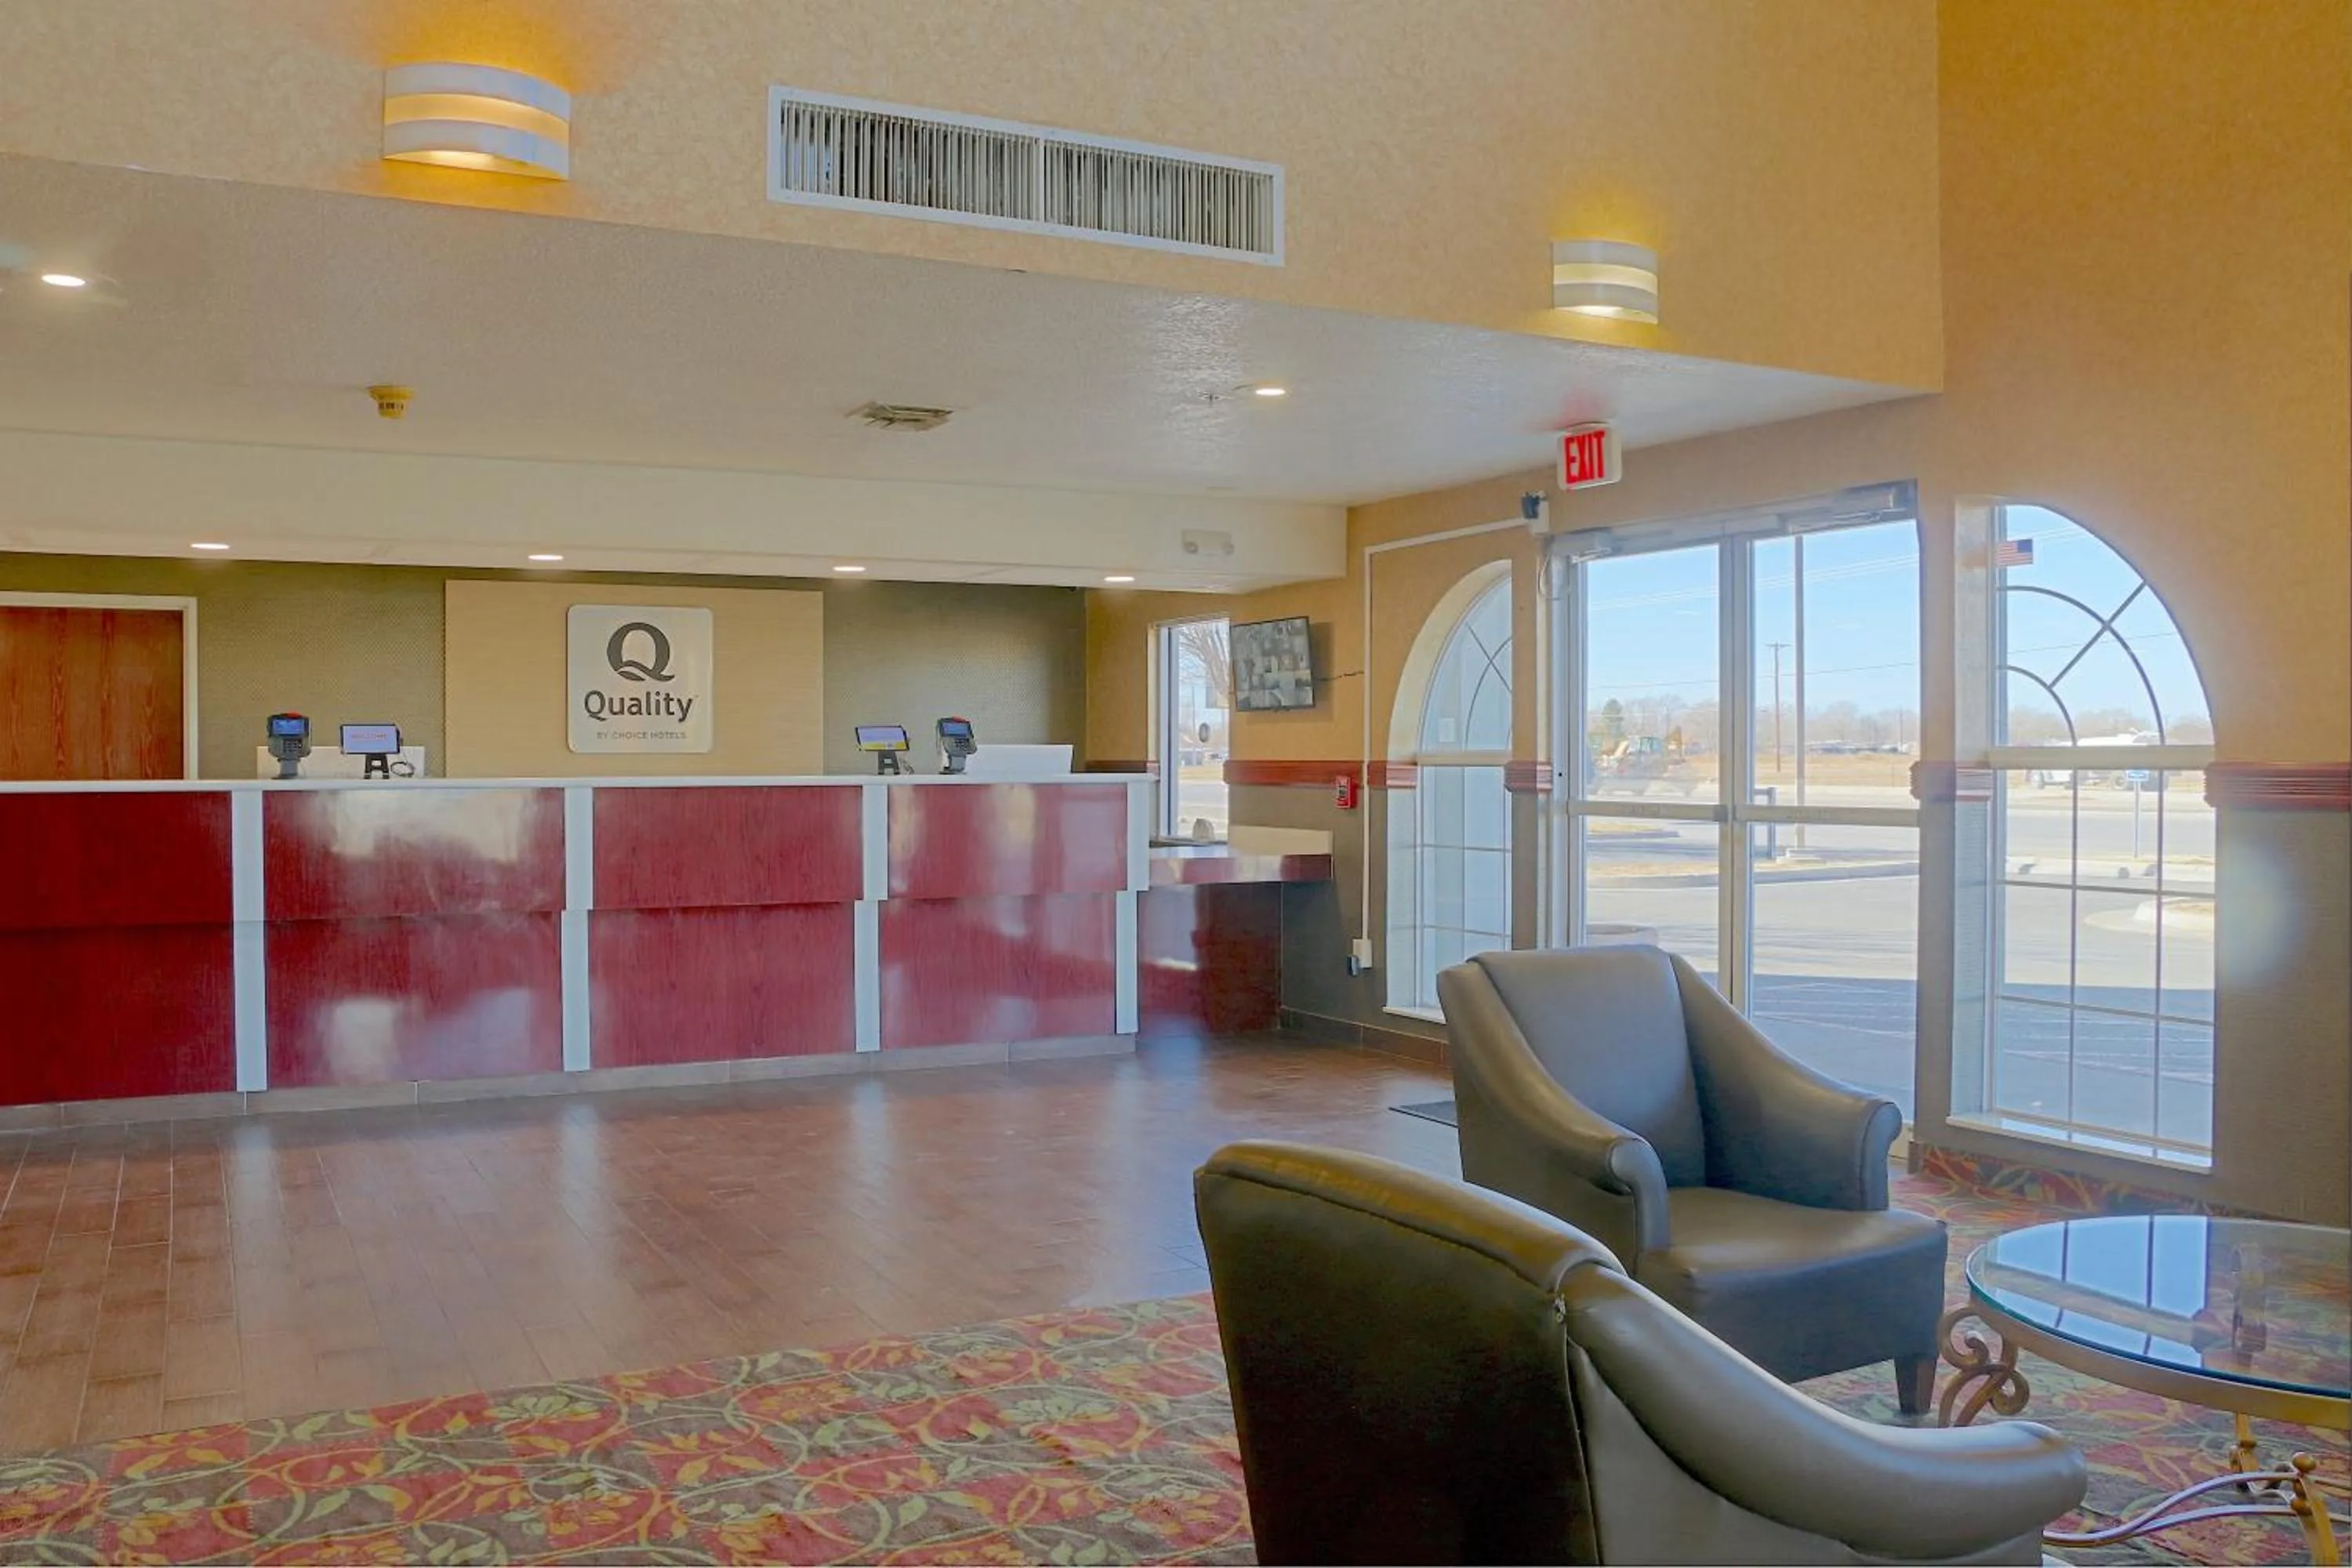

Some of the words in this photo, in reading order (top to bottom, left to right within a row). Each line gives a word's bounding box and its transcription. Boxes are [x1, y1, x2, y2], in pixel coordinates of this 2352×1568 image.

[1564, 430, 1606, 485] EXIT
[606, 622, 675, 681] Q
[584, 690, 692, 723] Quality
